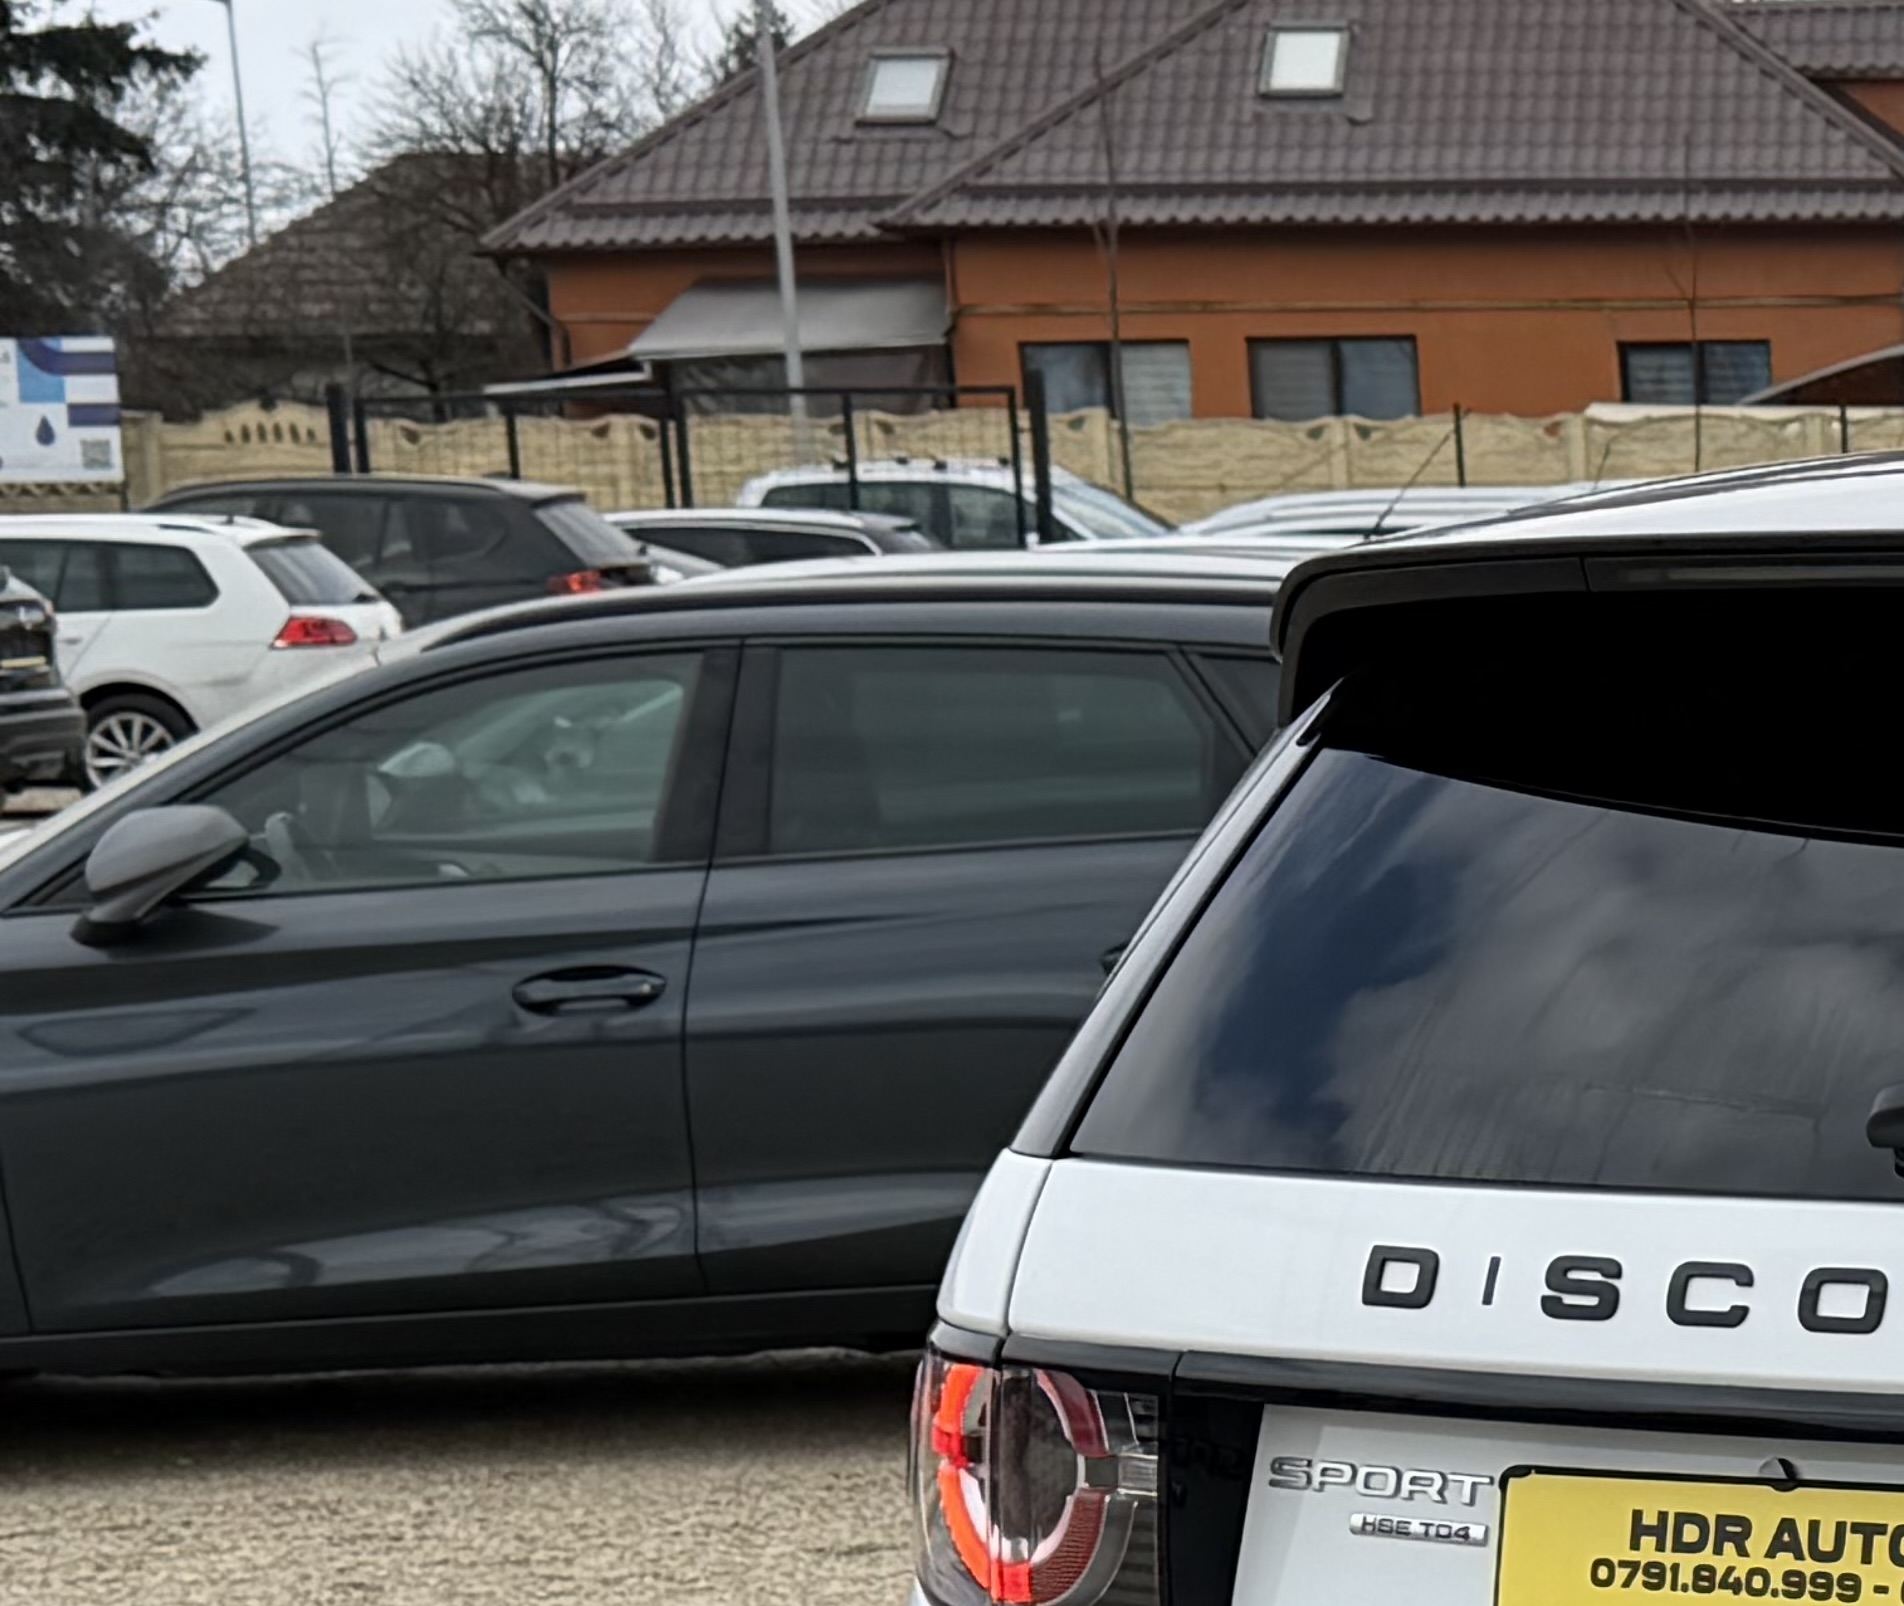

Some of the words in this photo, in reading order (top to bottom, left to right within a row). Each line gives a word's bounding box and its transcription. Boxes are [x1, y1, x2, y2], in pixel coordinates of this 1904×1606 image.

[1268, 1456, 1494, 1506] SPORT
[1361, 1515, 1412, 1537] HSE
[1419, 1521, 1471, 1541] TD4
[1629, 1508, 1752, 1558] HDR
[1590, 1558, 1862, 1603] 0791.840.999
